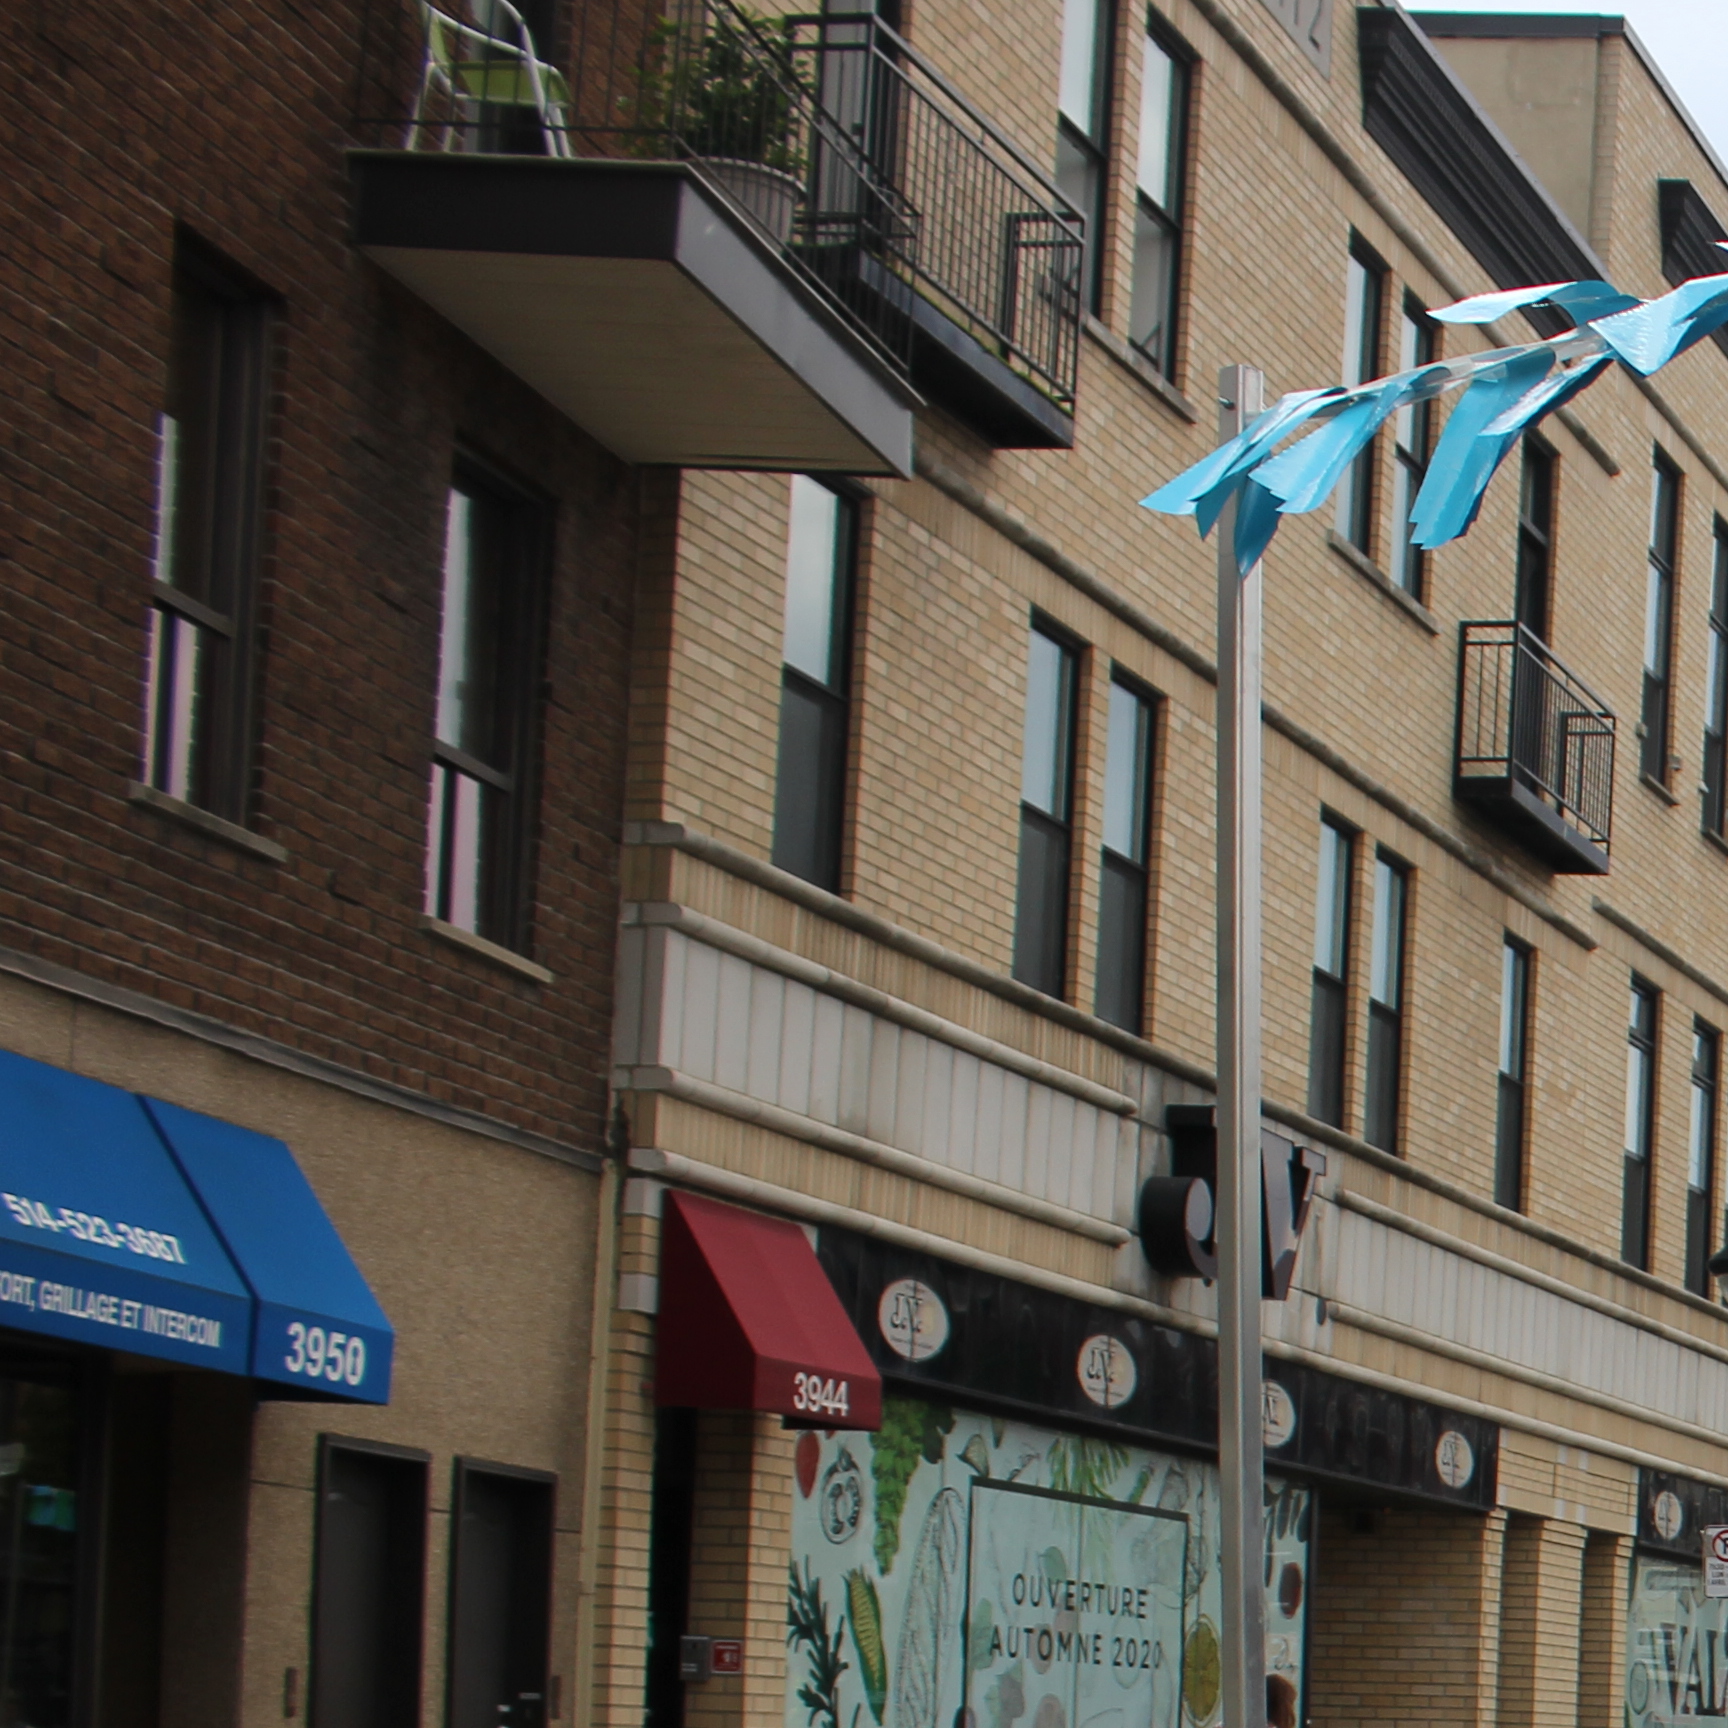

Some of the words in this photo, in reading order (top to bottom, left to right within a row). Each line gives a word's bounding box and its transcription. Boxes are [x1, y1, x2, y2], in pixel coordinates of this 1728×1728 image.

[1, 1192, 188, 1265] 514-523-3687
[0, 1270, 35, 1312] ORT,
[39, 1280, 119, 1323] GRILLAGE
[120, 1299, 140, 1329] ET
[143, 1304, 222, 1348] INTERCOM
[285, 1321, 366, 1386] 3950
[793, 1372, 849, 1417] 3944
[1012, 1573, 1149, 1619] OUVERTURE
[989, 1625, 1103, 1666] AUTOMNE
[1112, 1636, 1162, 1670] 2020
